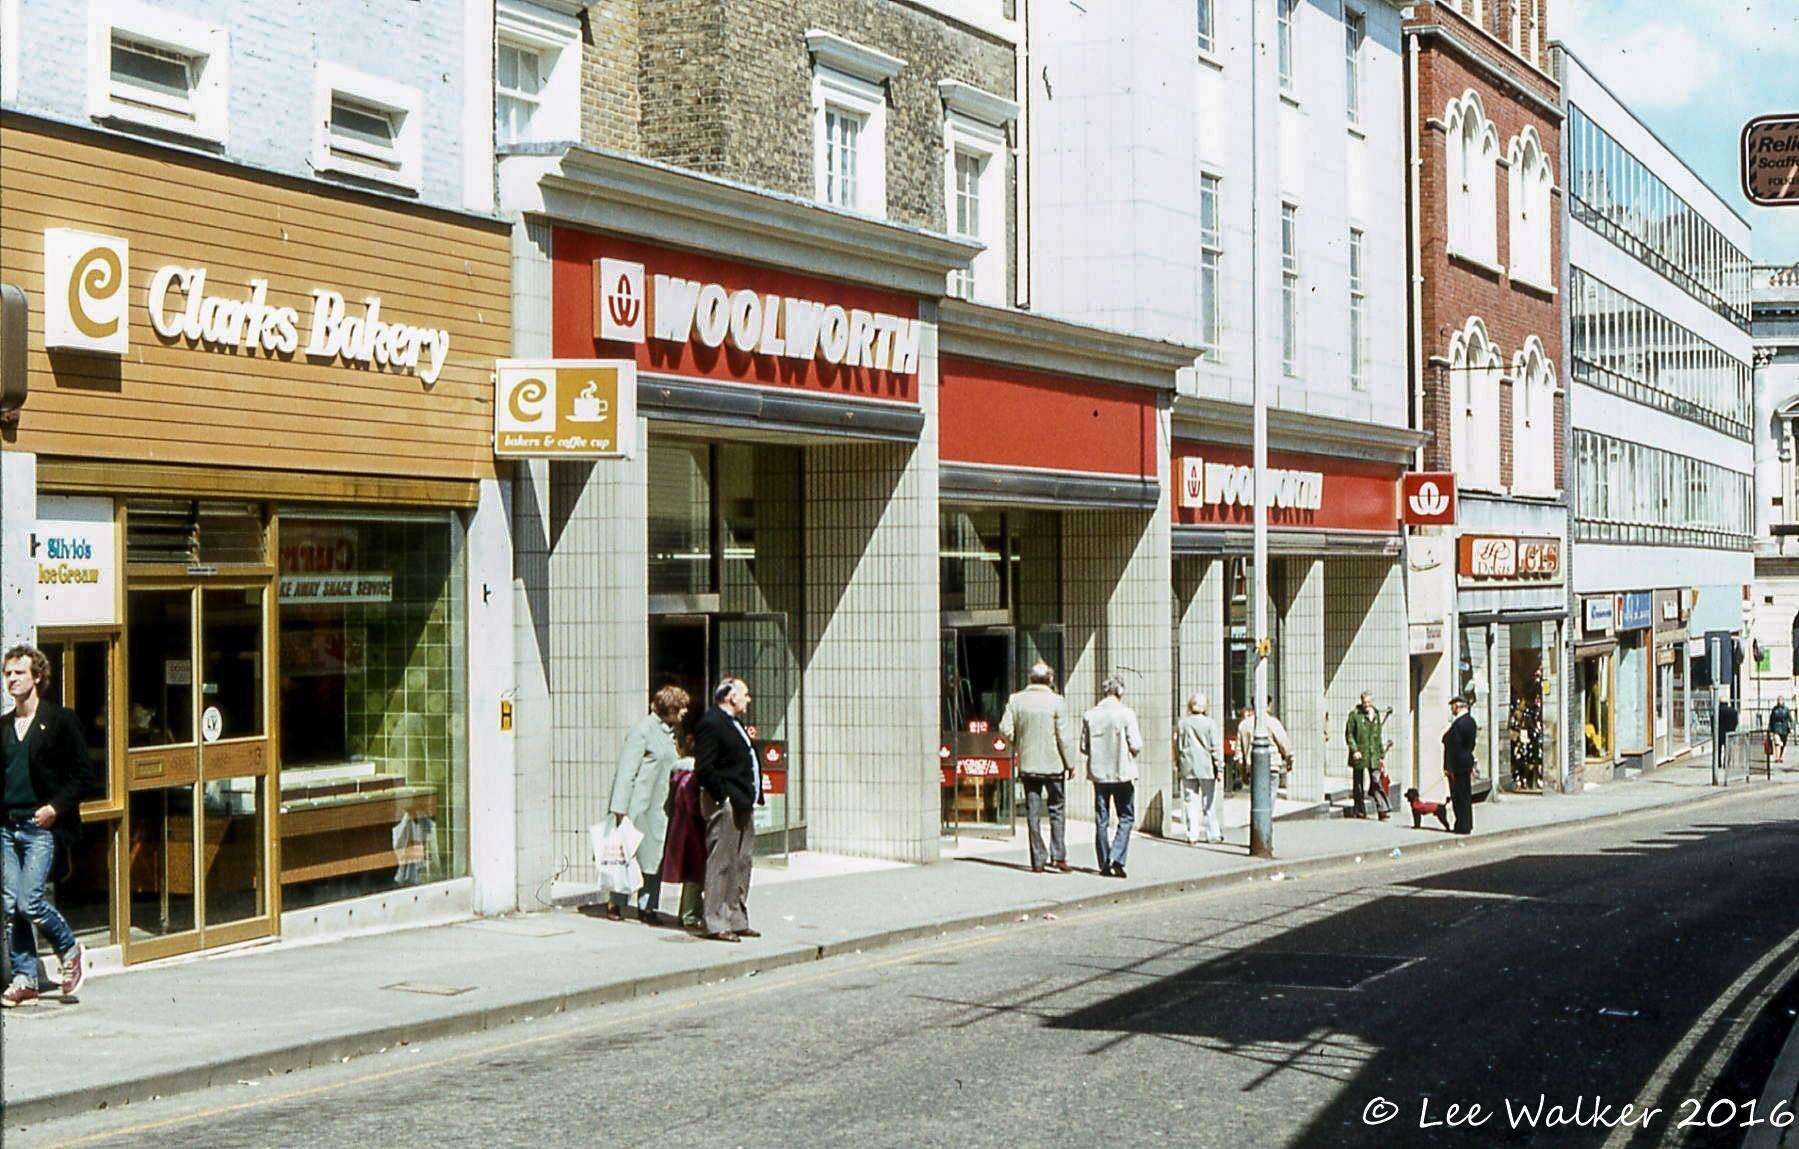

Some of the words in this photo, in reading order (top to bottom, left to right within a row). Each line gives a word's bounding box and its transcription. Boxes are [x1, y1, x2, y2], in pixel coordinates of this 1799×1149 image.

[149, 265, 298, 353] Clarks
[305, 288, 449, 384] Bakery
[652, 273, 922, 375] WOOLWORTH
[504, 434, 540, 447] bakers
[543, 435, 554, 447] &
[557, 436, 587, 450] coffee
[590, 438, 610, 450] cup
[1204, 462, 1324, 510] WOOWORTH
